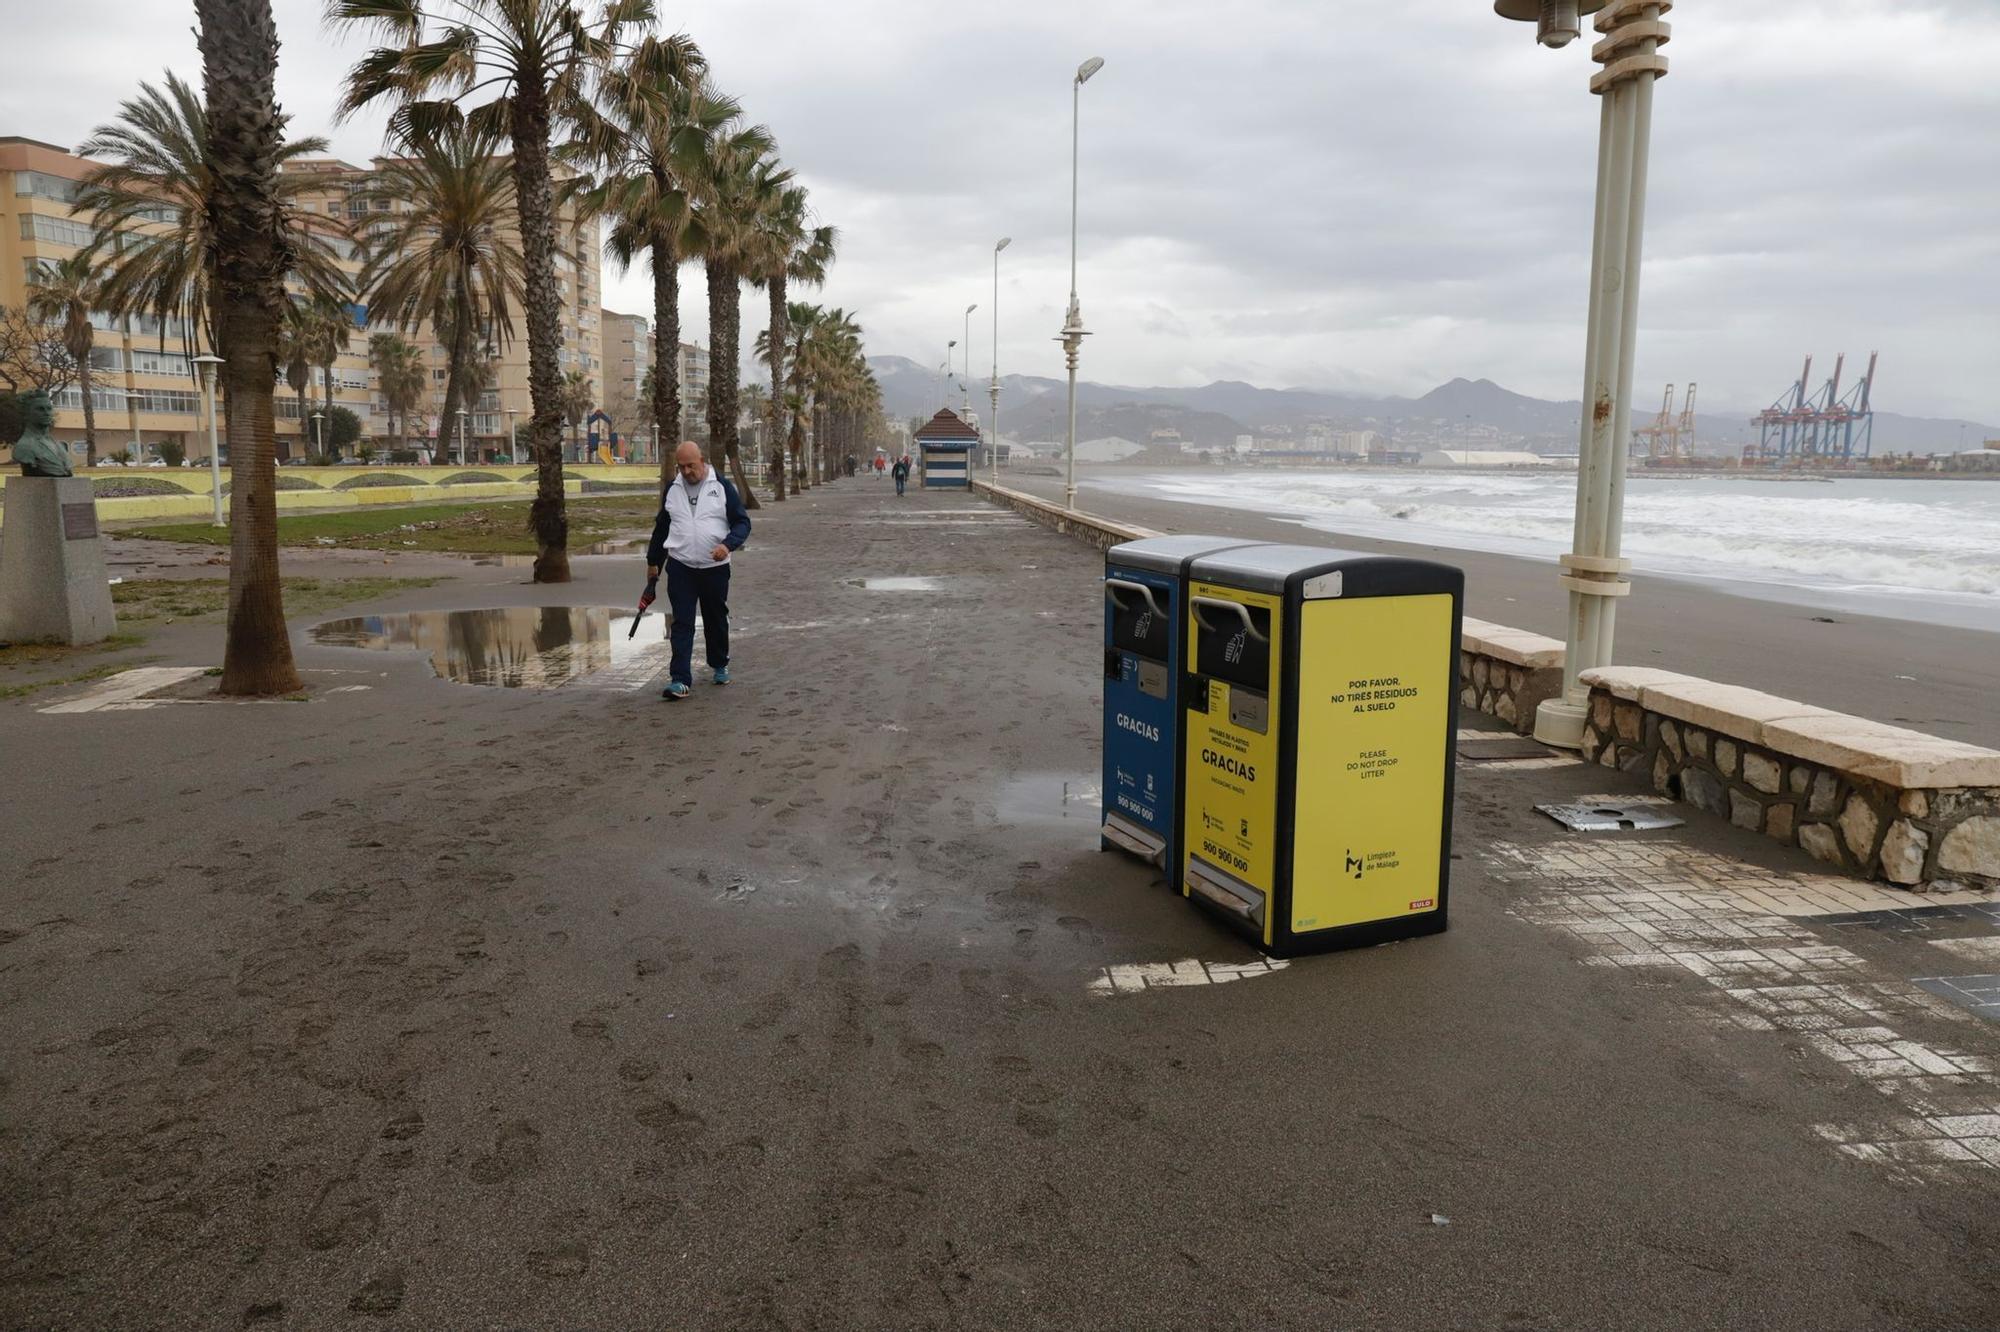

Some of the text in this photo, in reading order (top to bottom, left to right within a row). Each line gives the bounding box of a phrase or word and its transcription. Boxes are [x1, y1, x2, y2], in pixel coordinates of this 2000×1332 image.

[1349, 680, 1367, 689] POR
[1331, 688, 1418, 703] NO TIRES RESIDUOS
[1353, 702, 1395, 713] AL SUELO
[1116, 712, 1160, 742] GRACIAS
[1359, 750, 1387, 759] PLEASE
[1201, 748, 1256, 782] GRACIAS
[1346, 758, 1398, 771] DO NOT DROP
[1360, 769, 1385, 779] LITTER
[1141, 807, 1154, 822] 000
[1203, 840, 1217, 856] 900
[1217, 848, 1232, 864] 900
[1233, 857, 1248, 873] 000
[1367, 851, 1396, 862] Limpieza
[1366, 862, 1375, 871] de
[1411, 899, 1431, 909] SULO
